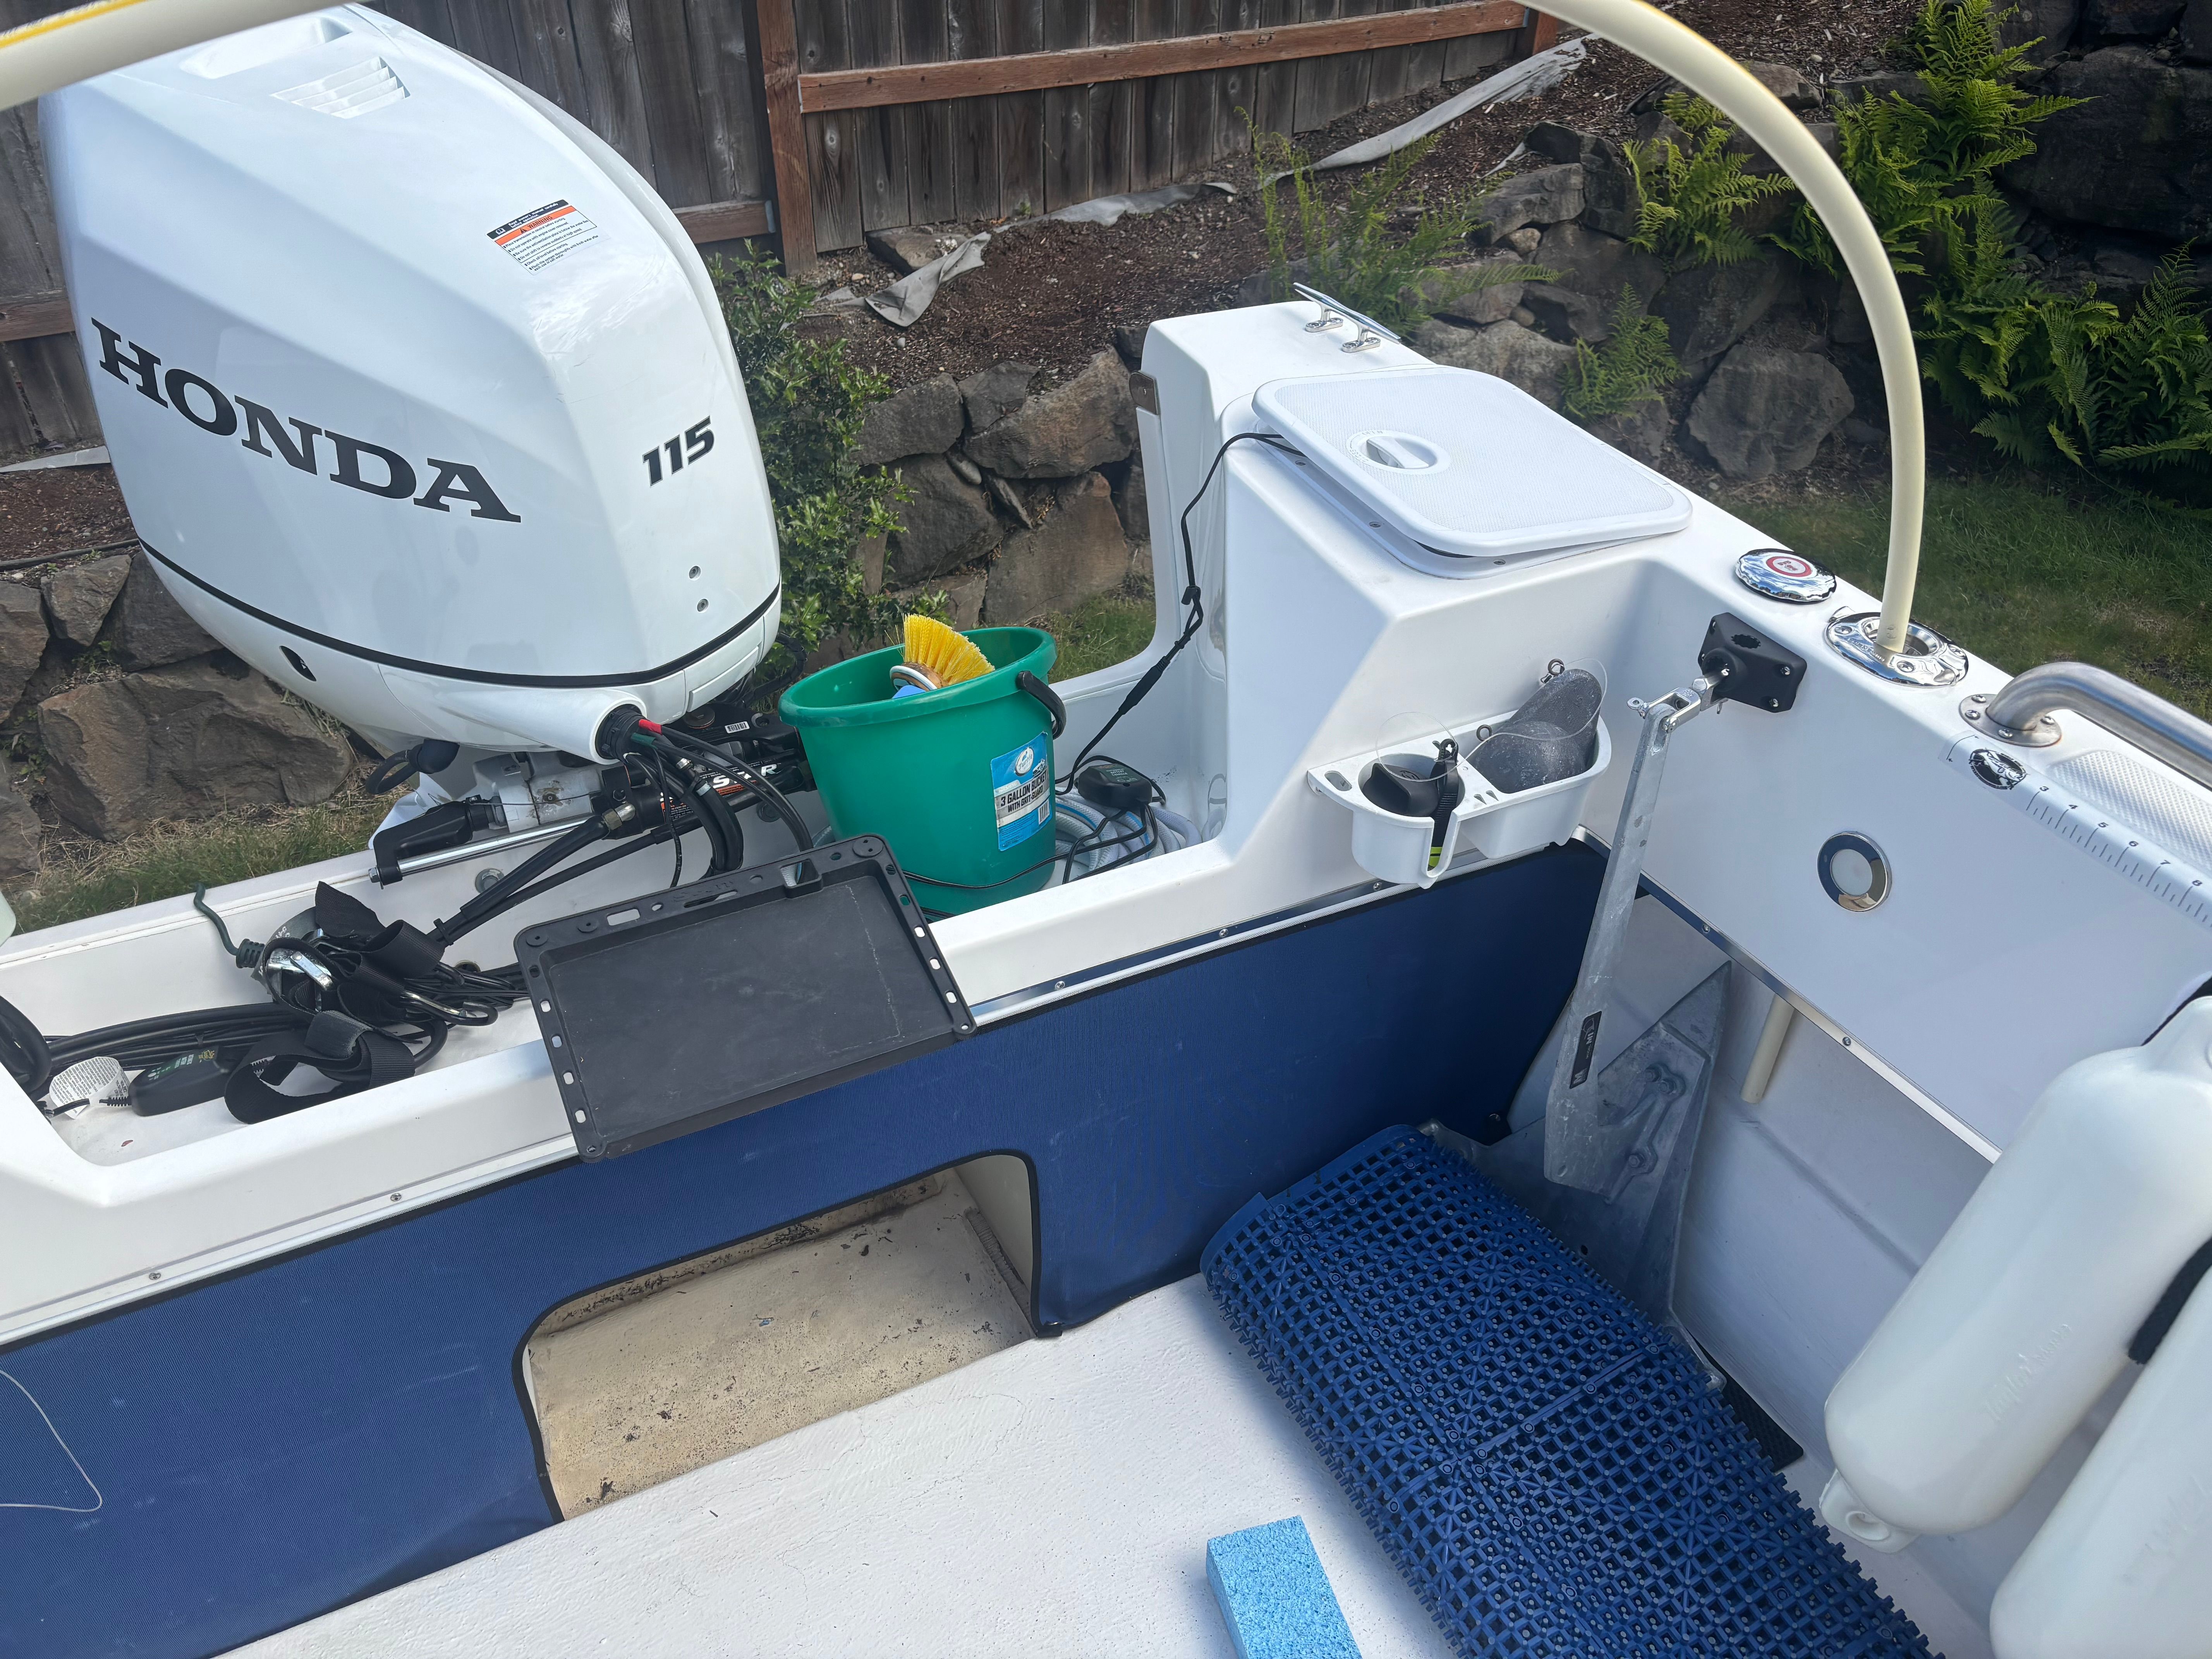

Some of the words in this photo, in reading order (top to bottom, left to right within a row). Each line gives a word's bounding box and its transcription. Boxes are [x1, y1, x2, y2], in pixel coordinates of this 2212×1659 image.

[527, 216, 553, 229] WARNING
[91, 317, 521, 523] HONDA
[642, 415, 714, 486] 115
[1001, 796, 1006, 807] 3
[1007, 783, 1030, 804] GALLON
[1031, 769, 1047, 791] BUCKET
[1008, 802, 1020, 813] WITH
[1021, 785, 1043, 806] GRIT-GUARD
